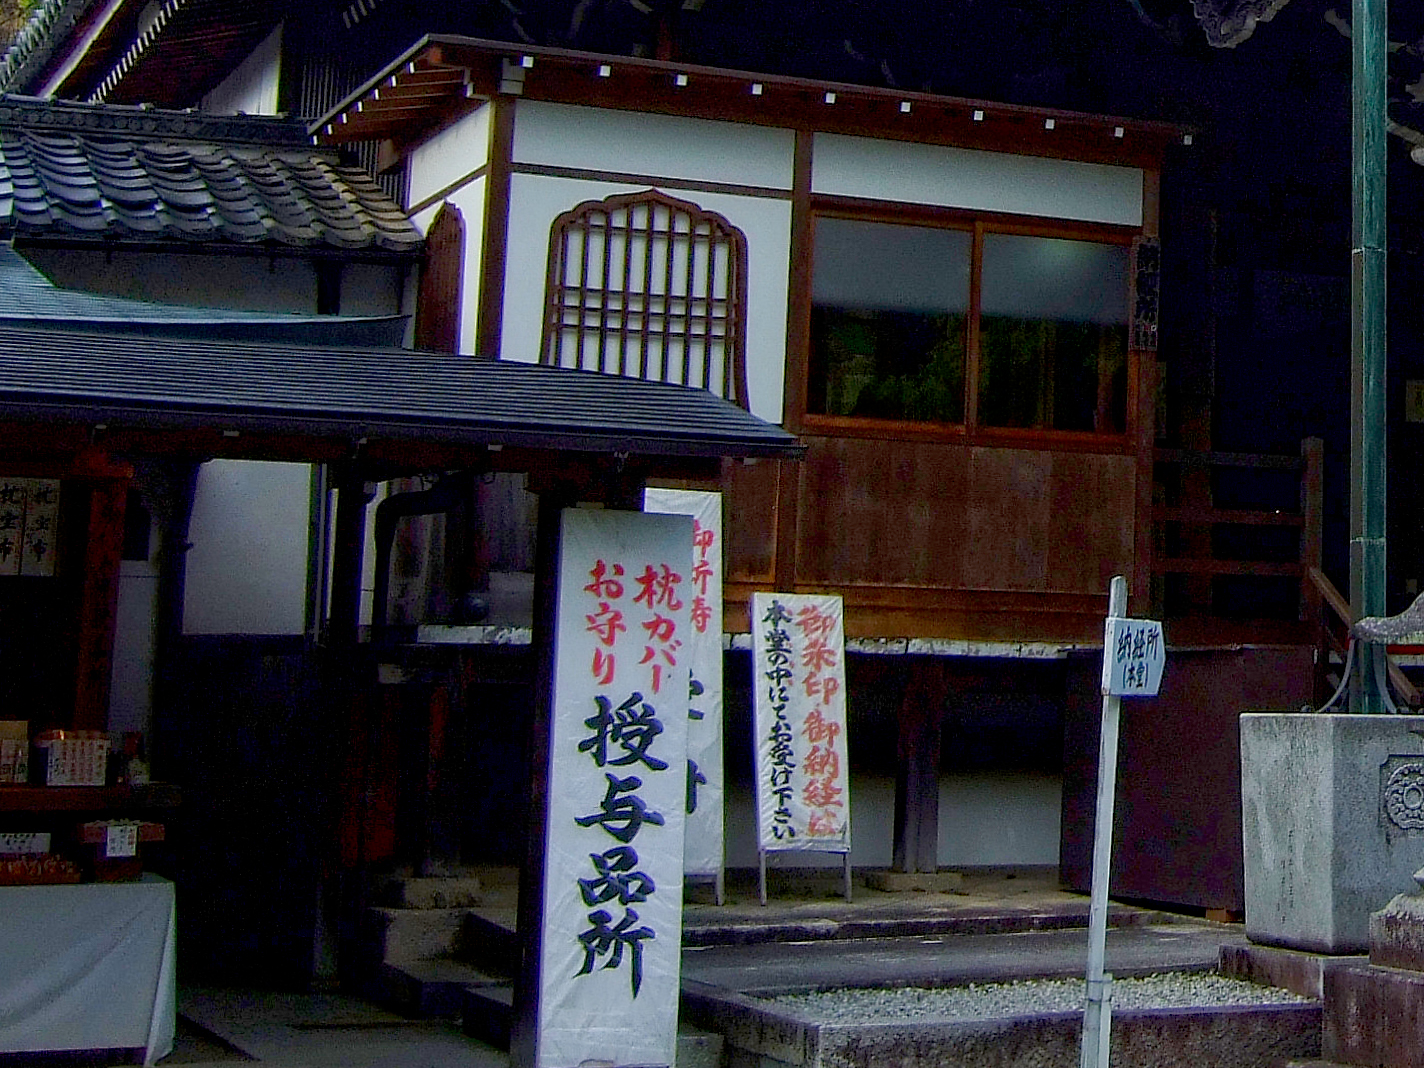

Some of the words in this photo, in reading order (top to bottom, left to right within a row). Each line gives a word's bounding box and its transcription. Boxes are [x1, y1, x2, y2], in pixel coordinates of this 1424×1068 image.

[583, 558, 627, 686] お守り
[633, 562, 684, 695] 枕カバー
[1117, 624, 1160, 663] 納経所
[761, 599, 796, 839] 本堂の中にてお受け下さい
[571, 691, 669, 1000] 授与品所
